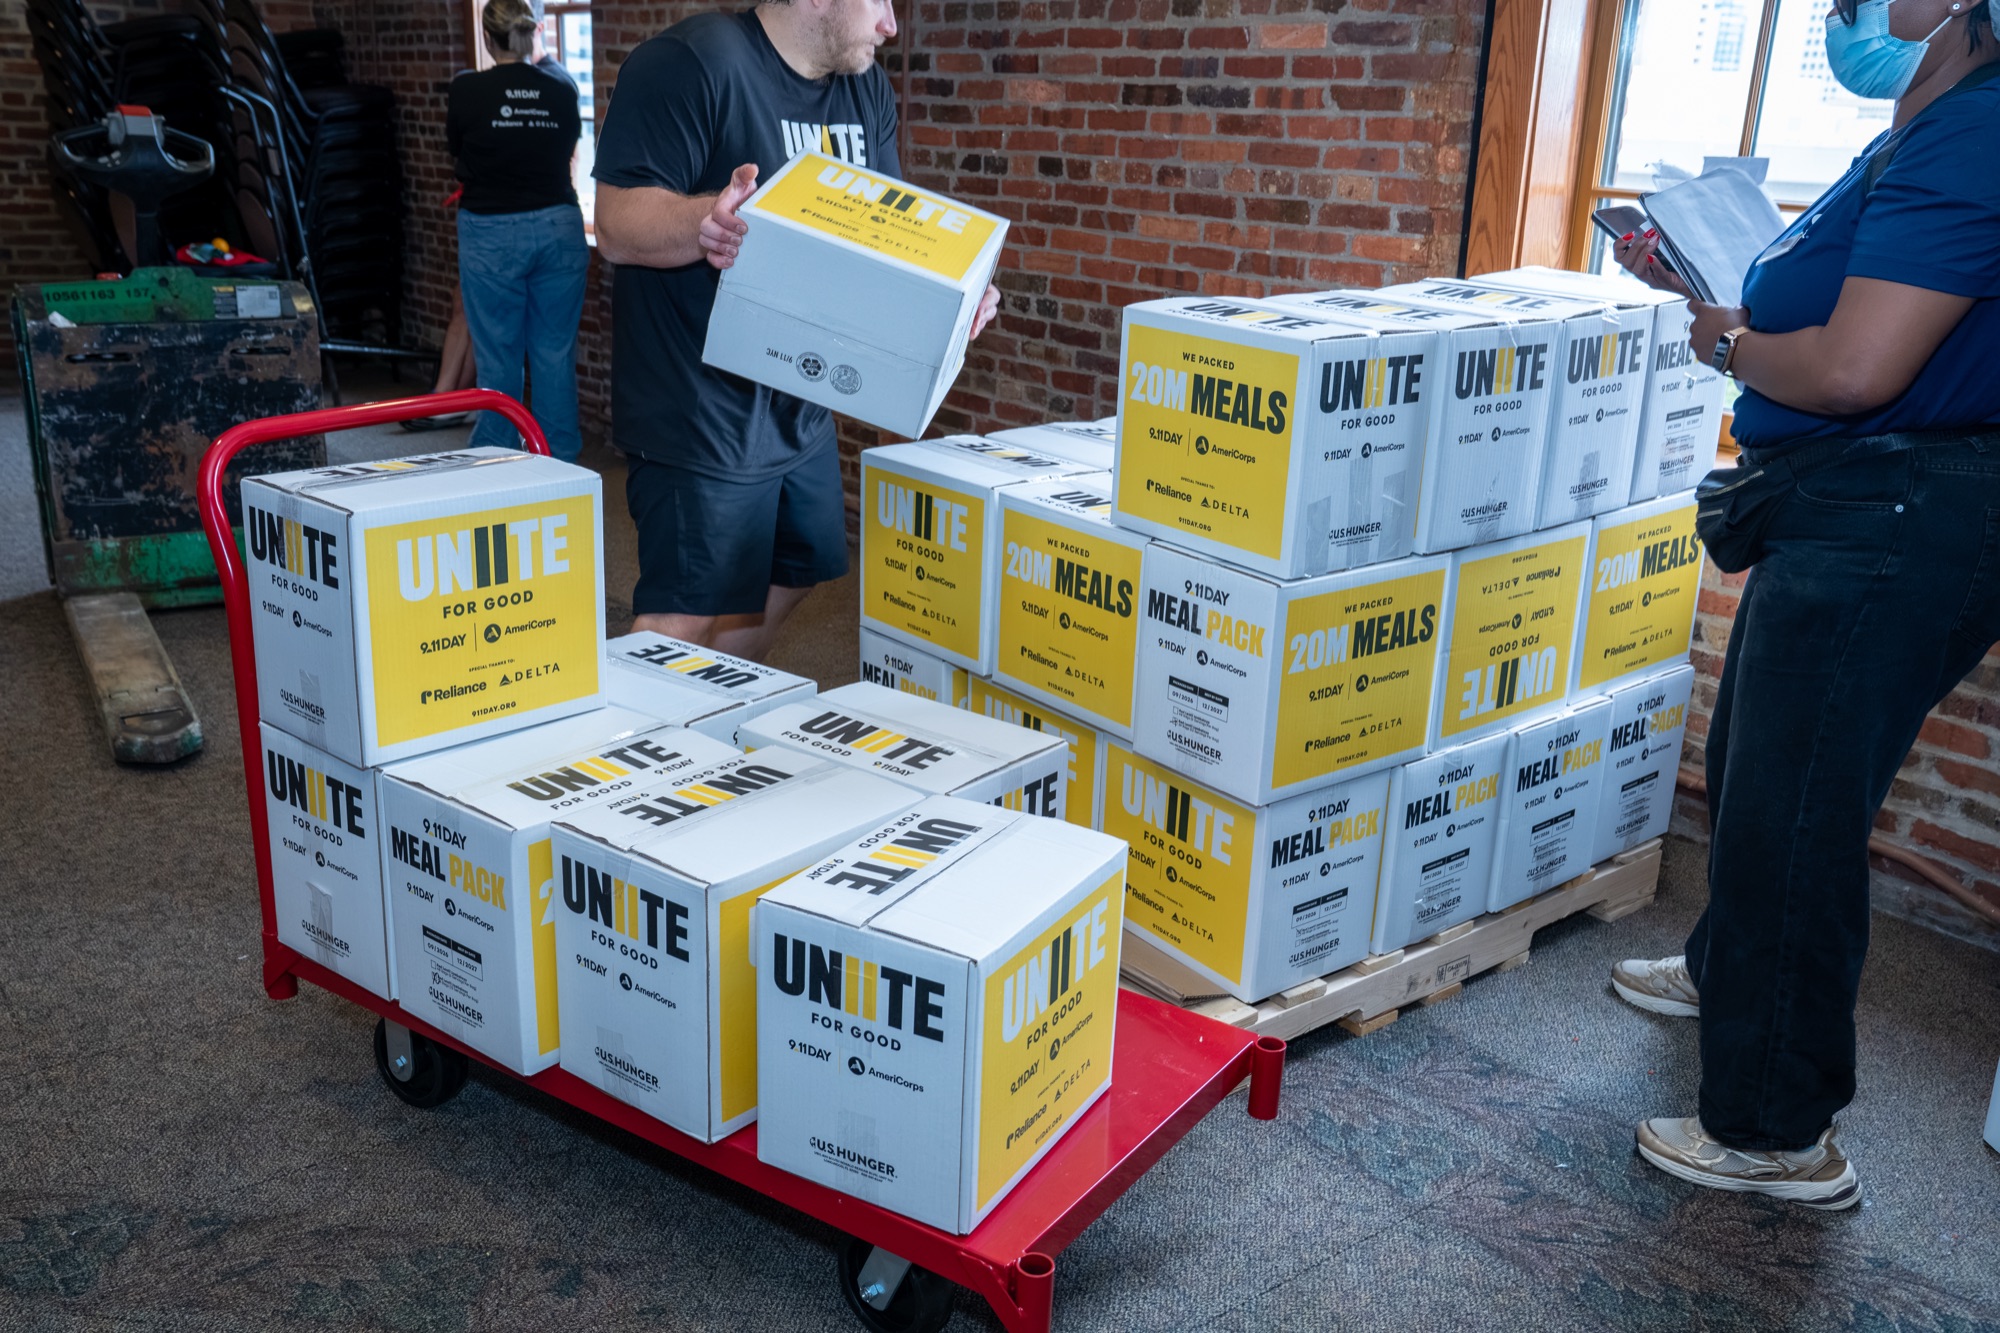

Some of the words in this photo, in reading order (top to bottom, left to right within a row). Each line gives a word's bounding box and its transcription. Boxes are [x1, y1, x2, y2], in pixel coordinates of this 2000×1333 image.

[535, 121, 559, 129] DELTA
[843, 195, 873, 209] FOR
[879, 207, 924, 227] GOOD
[811, 212, 860, 232] Reliance
[884, 238, 929, 258] DELTA
[889, 221, 938, 243] AmeriCorps
[766, 347, 779, 359] NYC
[1182, 351, 1196, 363] WE
[1198, 354, 1235, 371] PACKED
[1655, 339, 1692, 372] MEAL
[1130, 361, 1188, 412] 20M
[1191, 373, 1288, 435] MEALS
[1495, 399, 1522, 413] GOOD
[1365, 414, 1396, 427] GOOD
[1502, 426, 1530, 437] AmeriCorps
[1211, 444, 1256, 464] AmeriCorps
[1373, 442, 1405, 454] AmeriCorps
[1154, 482, 1192, 503] Reliance
[1212, 499, 1250, 519] DELTA
[1637, 532, 1647, 541] WE
[1648, 525, 1672, 538] PACKED
[917, 544, 945, 563] GOOD
[1047, 537, 1058, 548] WE
[1060, 541, 1090, 558] PACKED
[1595, 548, 1640, 593] 20M
[1640, 531, 1700, 579] MEALS
[926, 572, 957, 590] AmeriCorps
[1006, 541, 1053, 590] 20M
[1055, 557, 1133, 618] MEALS
[1525, 568, 1555, 582] Reliance
[291, 582, 319, 602] GOOD
[1482, 580, 1511, 595] DELTA
[1652, 586, 1680, 601] AmeriCorps
[443, 601, 477, 619] FOR
[484, 590, 534, 611] GOOD
[889, 594, 916, 613] Reliance
[930, 611, 957, 628] DELTA
[1344, 604, 1357, 614] WE
[1360, 597, 1393, 611] PACKED
[303, 618, 333, 638] AmeriCorps
[504, 617, 557, 636] AmeriCorps
[1072, 620, 1109, 642] AmeriCorps
[1147, 588, 1202, 636] MEAL
[1206, 609, 1266, 659] PACK
[1478, 619, 1511, 634] AmeriCorps
[1288, 623, 1349, 675] 20M
[1352, 603, 1436, 660] MEALS
[1489, 641, 1518, 657] GOOD
[1610, 640, 1637, 657] Reliance
[1649, 627, 1673, 643] DELTA
[715, 654, 750, 668] GOOD
[1027, 649, 1058, 670] Reliance
[1074, 670, 1105, 689] DELTA
[1209, 657, 1247, 678] AmeriCorps
[433, 680, 487, 702] Reliance
[514, 662, 560, 683] DELTA
[1370, 669, 1410, 686] AmeriCorps
[471, 701, 516, 718] 911DAY.ORG
[1313, 732, 1351, 750] Reliance
[1370, 717, 1403, 735] DELTA
[1609, 717, 1646, 753] MEAL
[1650, 703, 1685, 736] PACK
[811, 740, 852, 757] GOOD
[720, 758, 747, 771] FOR
[1516, 754, 1559, 793] MEAL
[1561, 738, 1603, 776] PACK
[671, 769, 715, 788] GOOD
[1563, 779, 1589, 794] AmeriCorps
[550, 795, 584, 811] FOR
[587, 780, 633, 799] GOOD
[1405, 790, 1451, 830] MEAL
[1454, 772, 1500, 812] PACK
[292, 814, 311, 832] FOR
[314, 826, 343, 847] GOOD
[893, 812, 922, 828] FOR
[1456, 816, 1485, 832] AmeriCorps
[858, 827, 896, 849] GOOD
[1271, 826, 1325, 869] MEAL
[1328, 807, 1381, 850] PACK
[1143, 830, 1165, 851] FOR
[1168, 844, 1203, 870] GOOD
[326, 859, 359, 882] AmeriCorps
[391, 825, 446, 882] MEAL
[449, 853, 507, 912] PACK
[1332, 854, 1364, 871] AmeriCorps
[1179, 876, 1216, 903] AmeriCorps
[457, 907, 495, 932] AmeriCorps
[1132, 889, 1164, 914] Reliance
[1181, 917, 1214, 943] DELTA
[591, 930, 616, 950] FOR
[620, 944, 658, 970] GOOD
[634, 983, 677, 1010] AmeriCorps
[1027, 1021, 1048, 1050] FOR
[1052, 990, 1082, 1026] GOOD
[1061, 1012, 1093, 1047] AmeriCorps
[811, 1012, 843, 1034] FOR
[850, 1026, 902, 1051] GOOD
[868, 1067, 924, 1093] AmeriCorps
[1014, 1103, 1047, 1142] Reliance
[1063, 1058, 1091, 1093] DELTA
